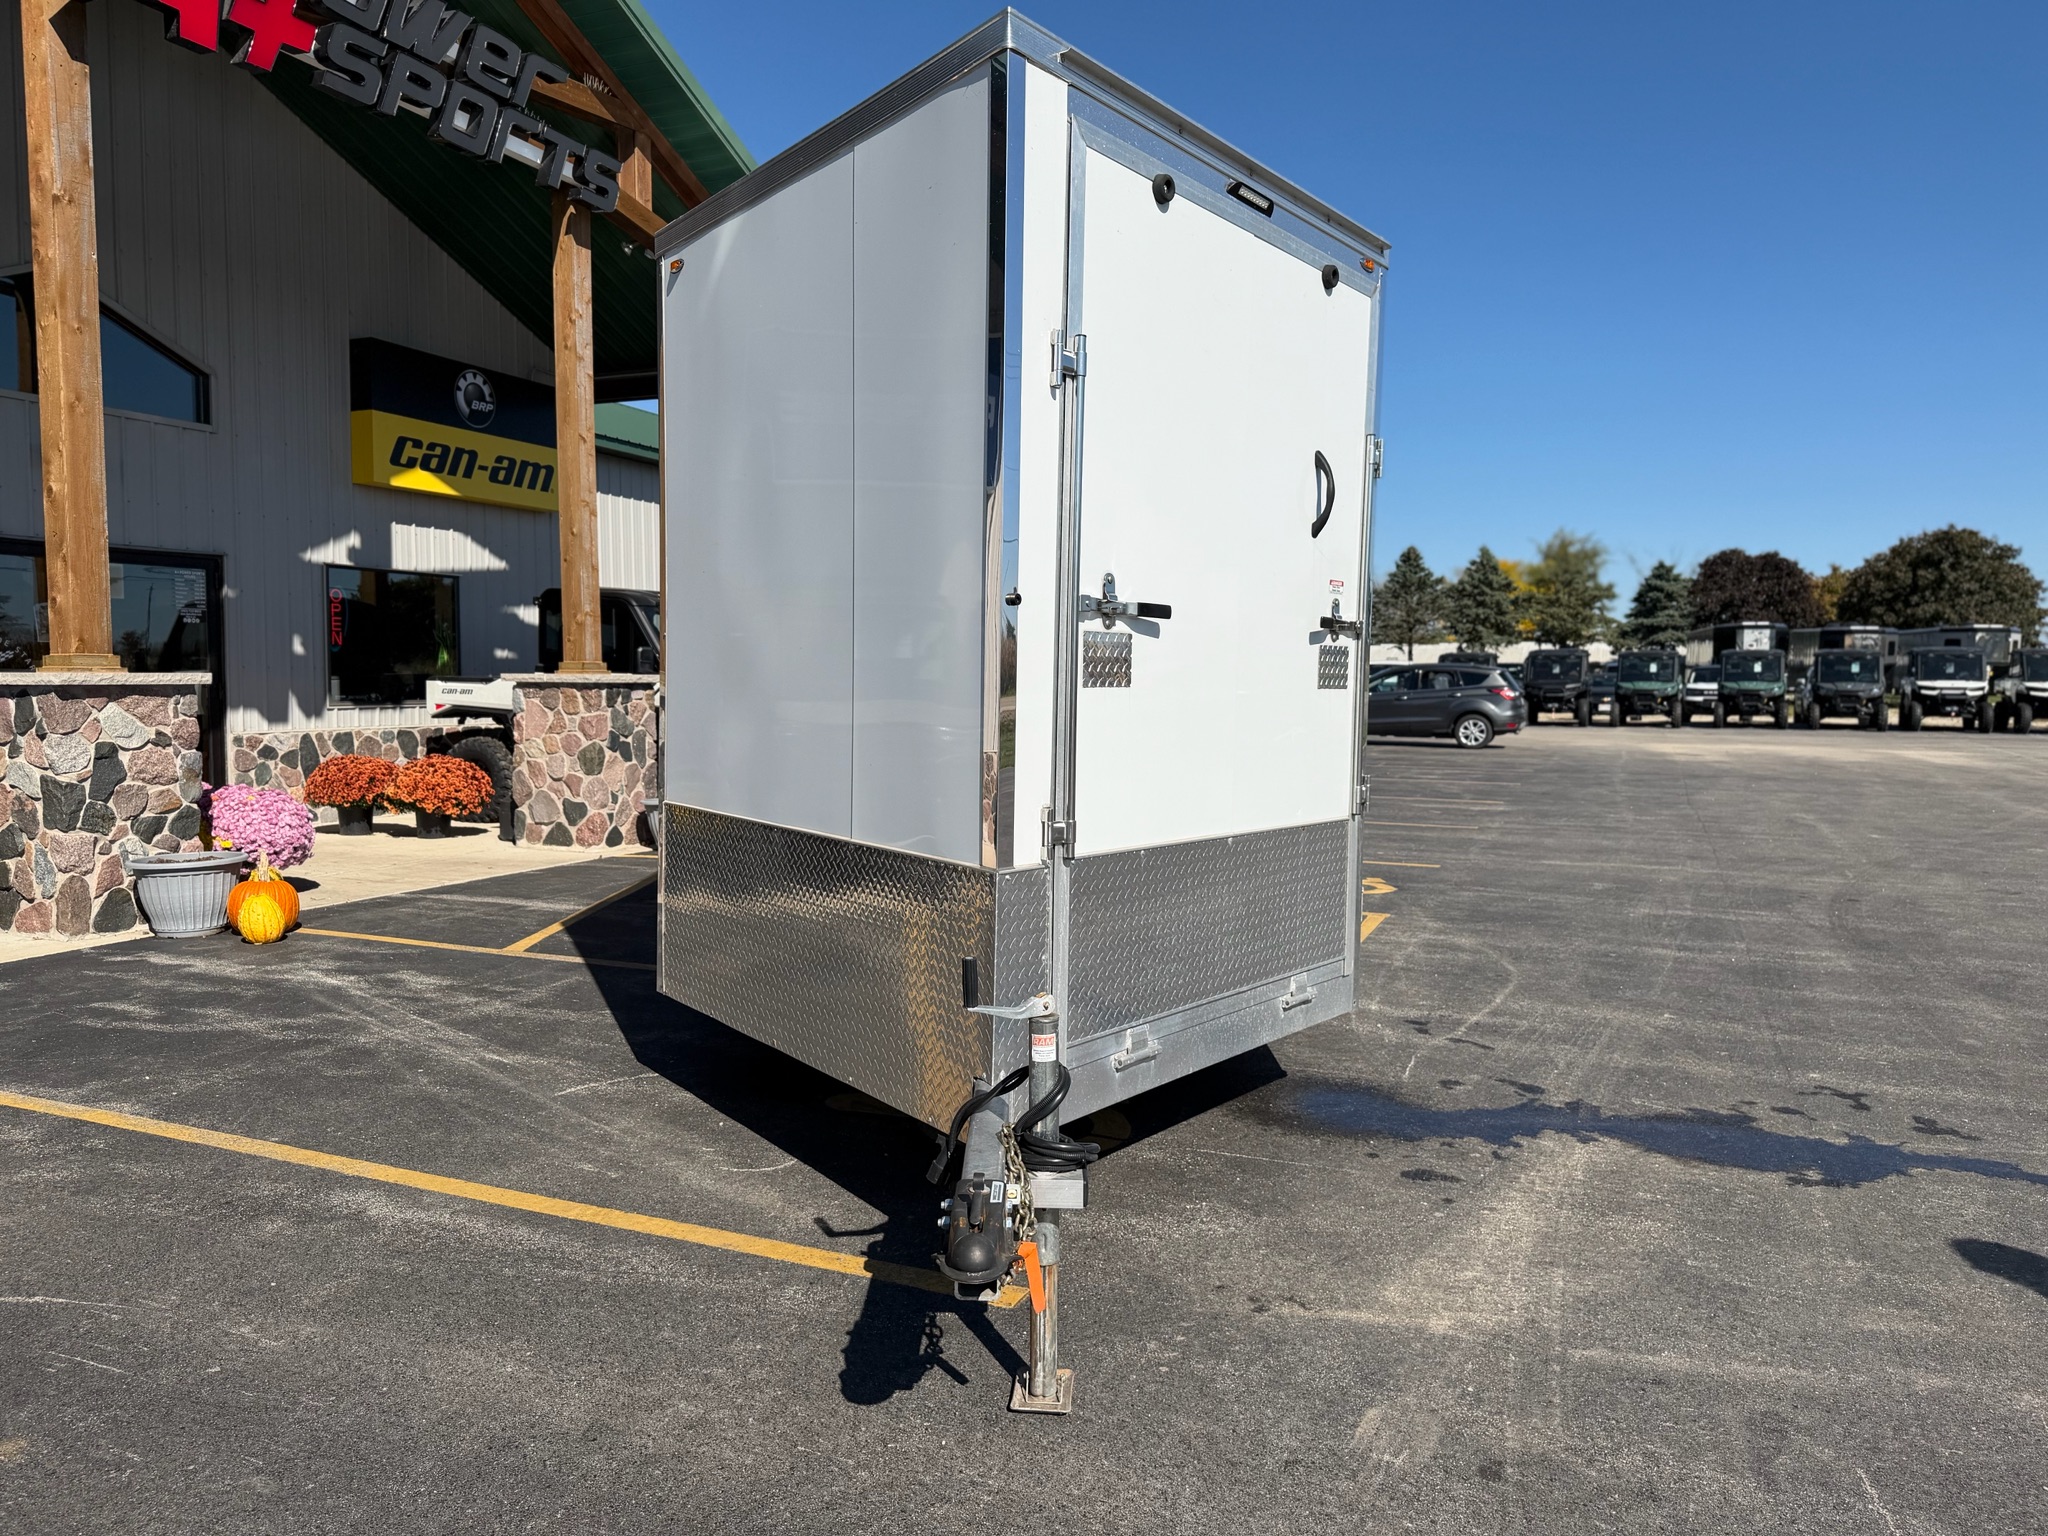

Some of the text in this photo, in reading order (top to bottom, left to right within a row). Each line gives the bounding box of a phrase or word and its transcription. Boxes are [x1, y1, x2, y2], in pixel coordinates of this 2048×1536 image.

[471, 400, 494, 413] BRP
[389, 435, 555, 493] can-am
[329, 588, 343, 646] OPEN
[441, 687, 474, 695] can-am
[1033, 1037, 1055, 1046] RAM
